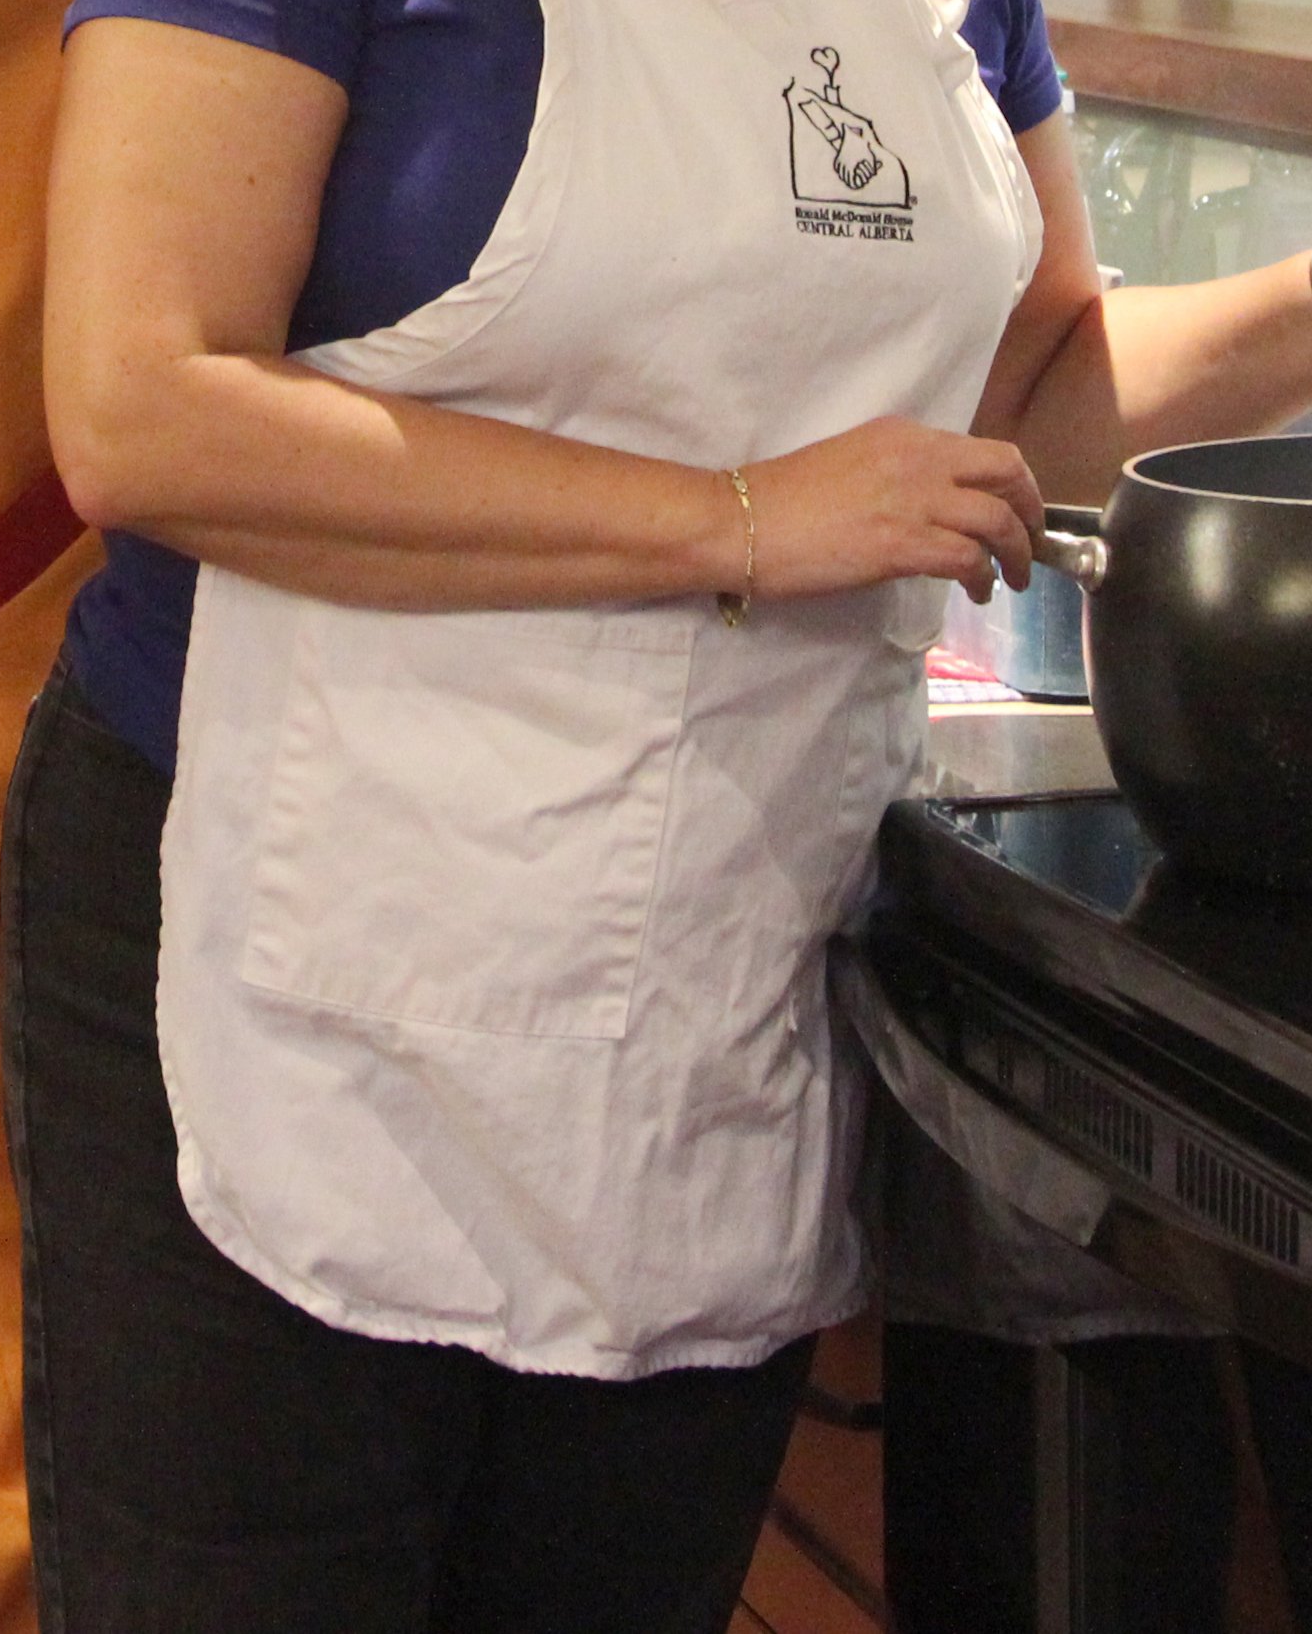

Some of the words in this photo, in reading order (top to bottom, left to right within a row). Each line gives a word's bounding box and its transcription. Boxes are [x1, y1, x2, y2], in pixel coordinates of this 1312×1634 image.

[795, 207, 829, 220] Ronald
[833, 210, 881, 223] McDonald
[797, 220, 853, 237] CENTRAL
[859, 225, 914, 241] ALBERTA
